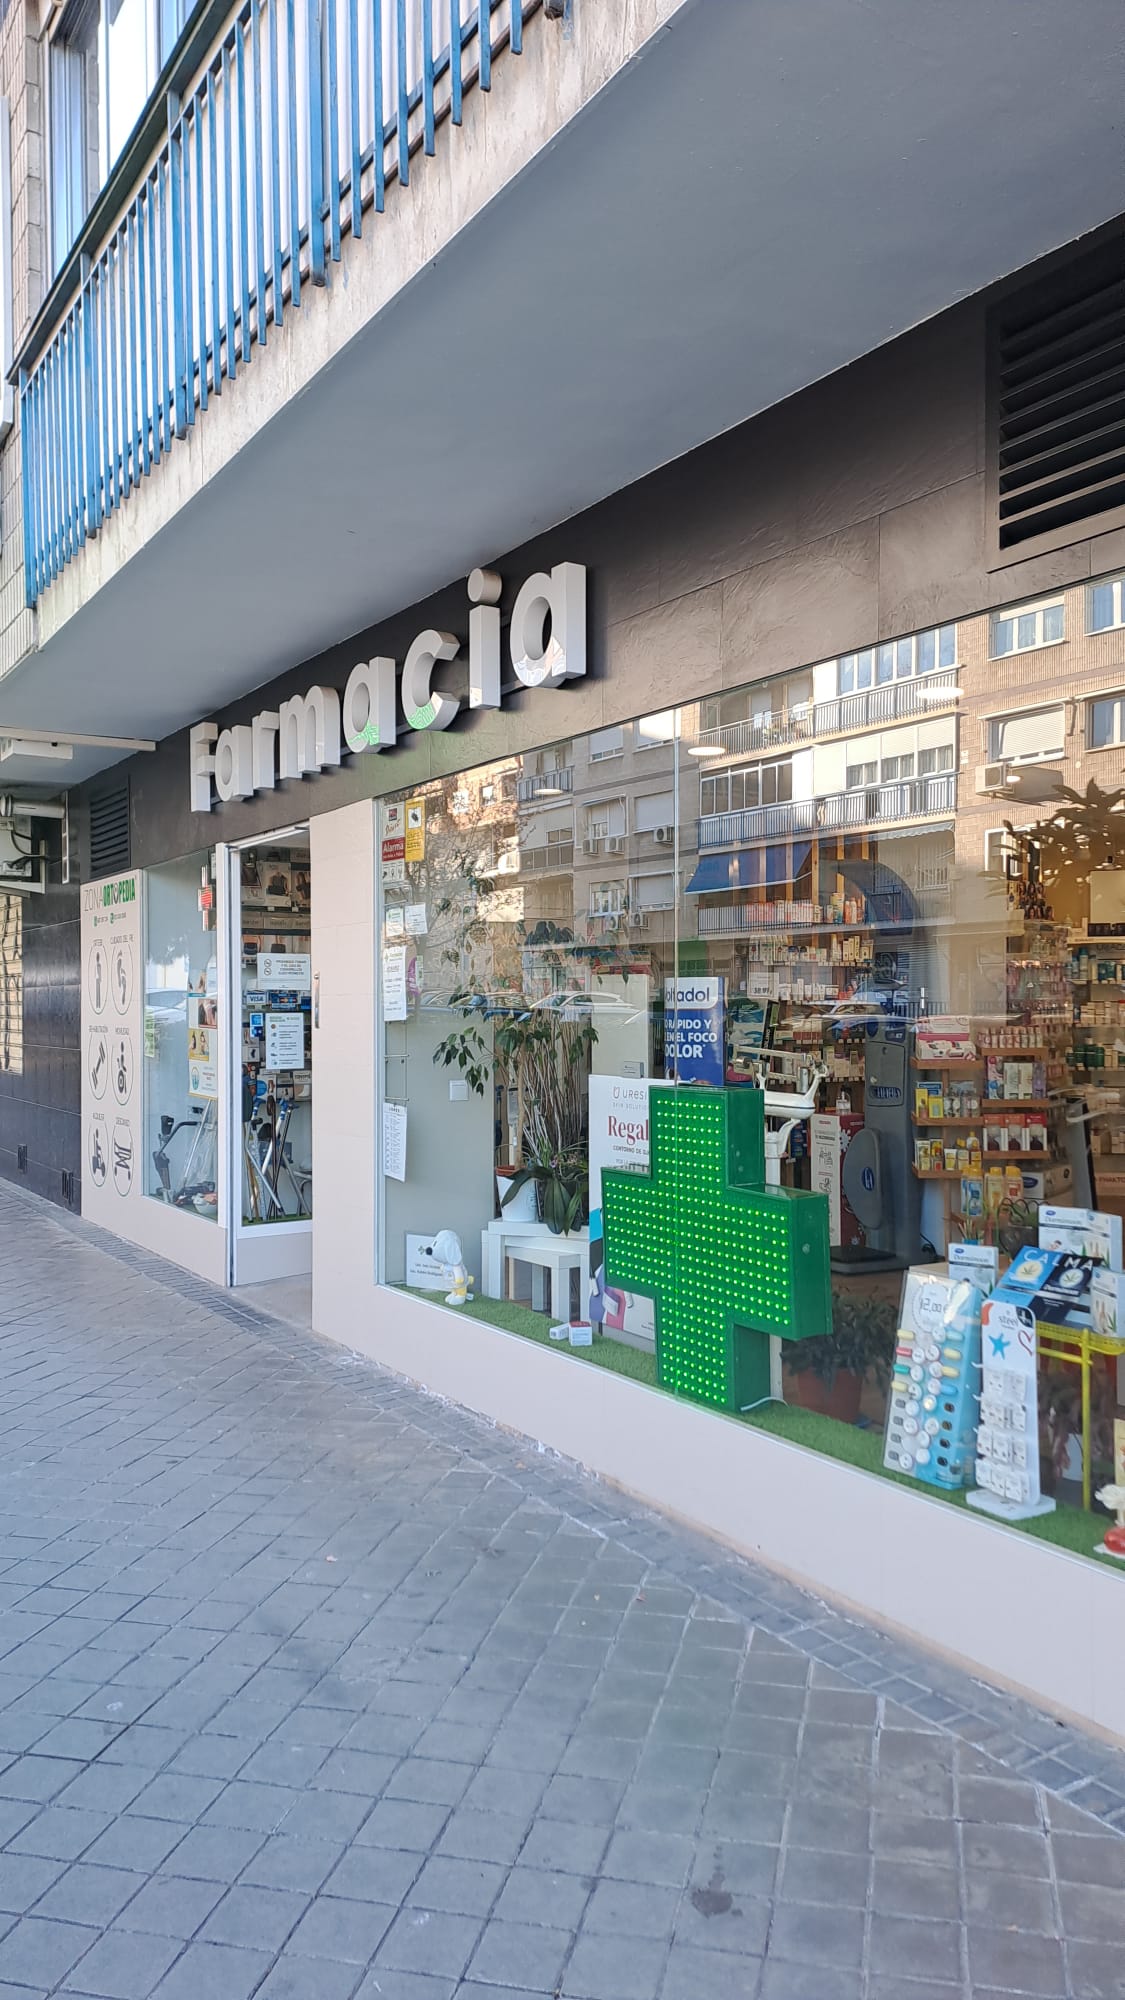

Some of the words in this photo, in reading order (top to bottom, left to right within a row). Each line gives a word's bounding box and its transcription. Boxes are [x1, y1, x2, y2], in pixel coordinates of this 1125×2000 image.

[190, 561, 587, 812] Farmacia
[383, 841, 404, 853] Alarma
[103, 878, 135, 907] ORTOPEDIA
[704, 1019, 712, 1029] Y
[688, 1032, 718, 1042] FOCO
[608, 1115, 650, 1145] Regal
[1024, 1249, 1094, 1271] CALMA
